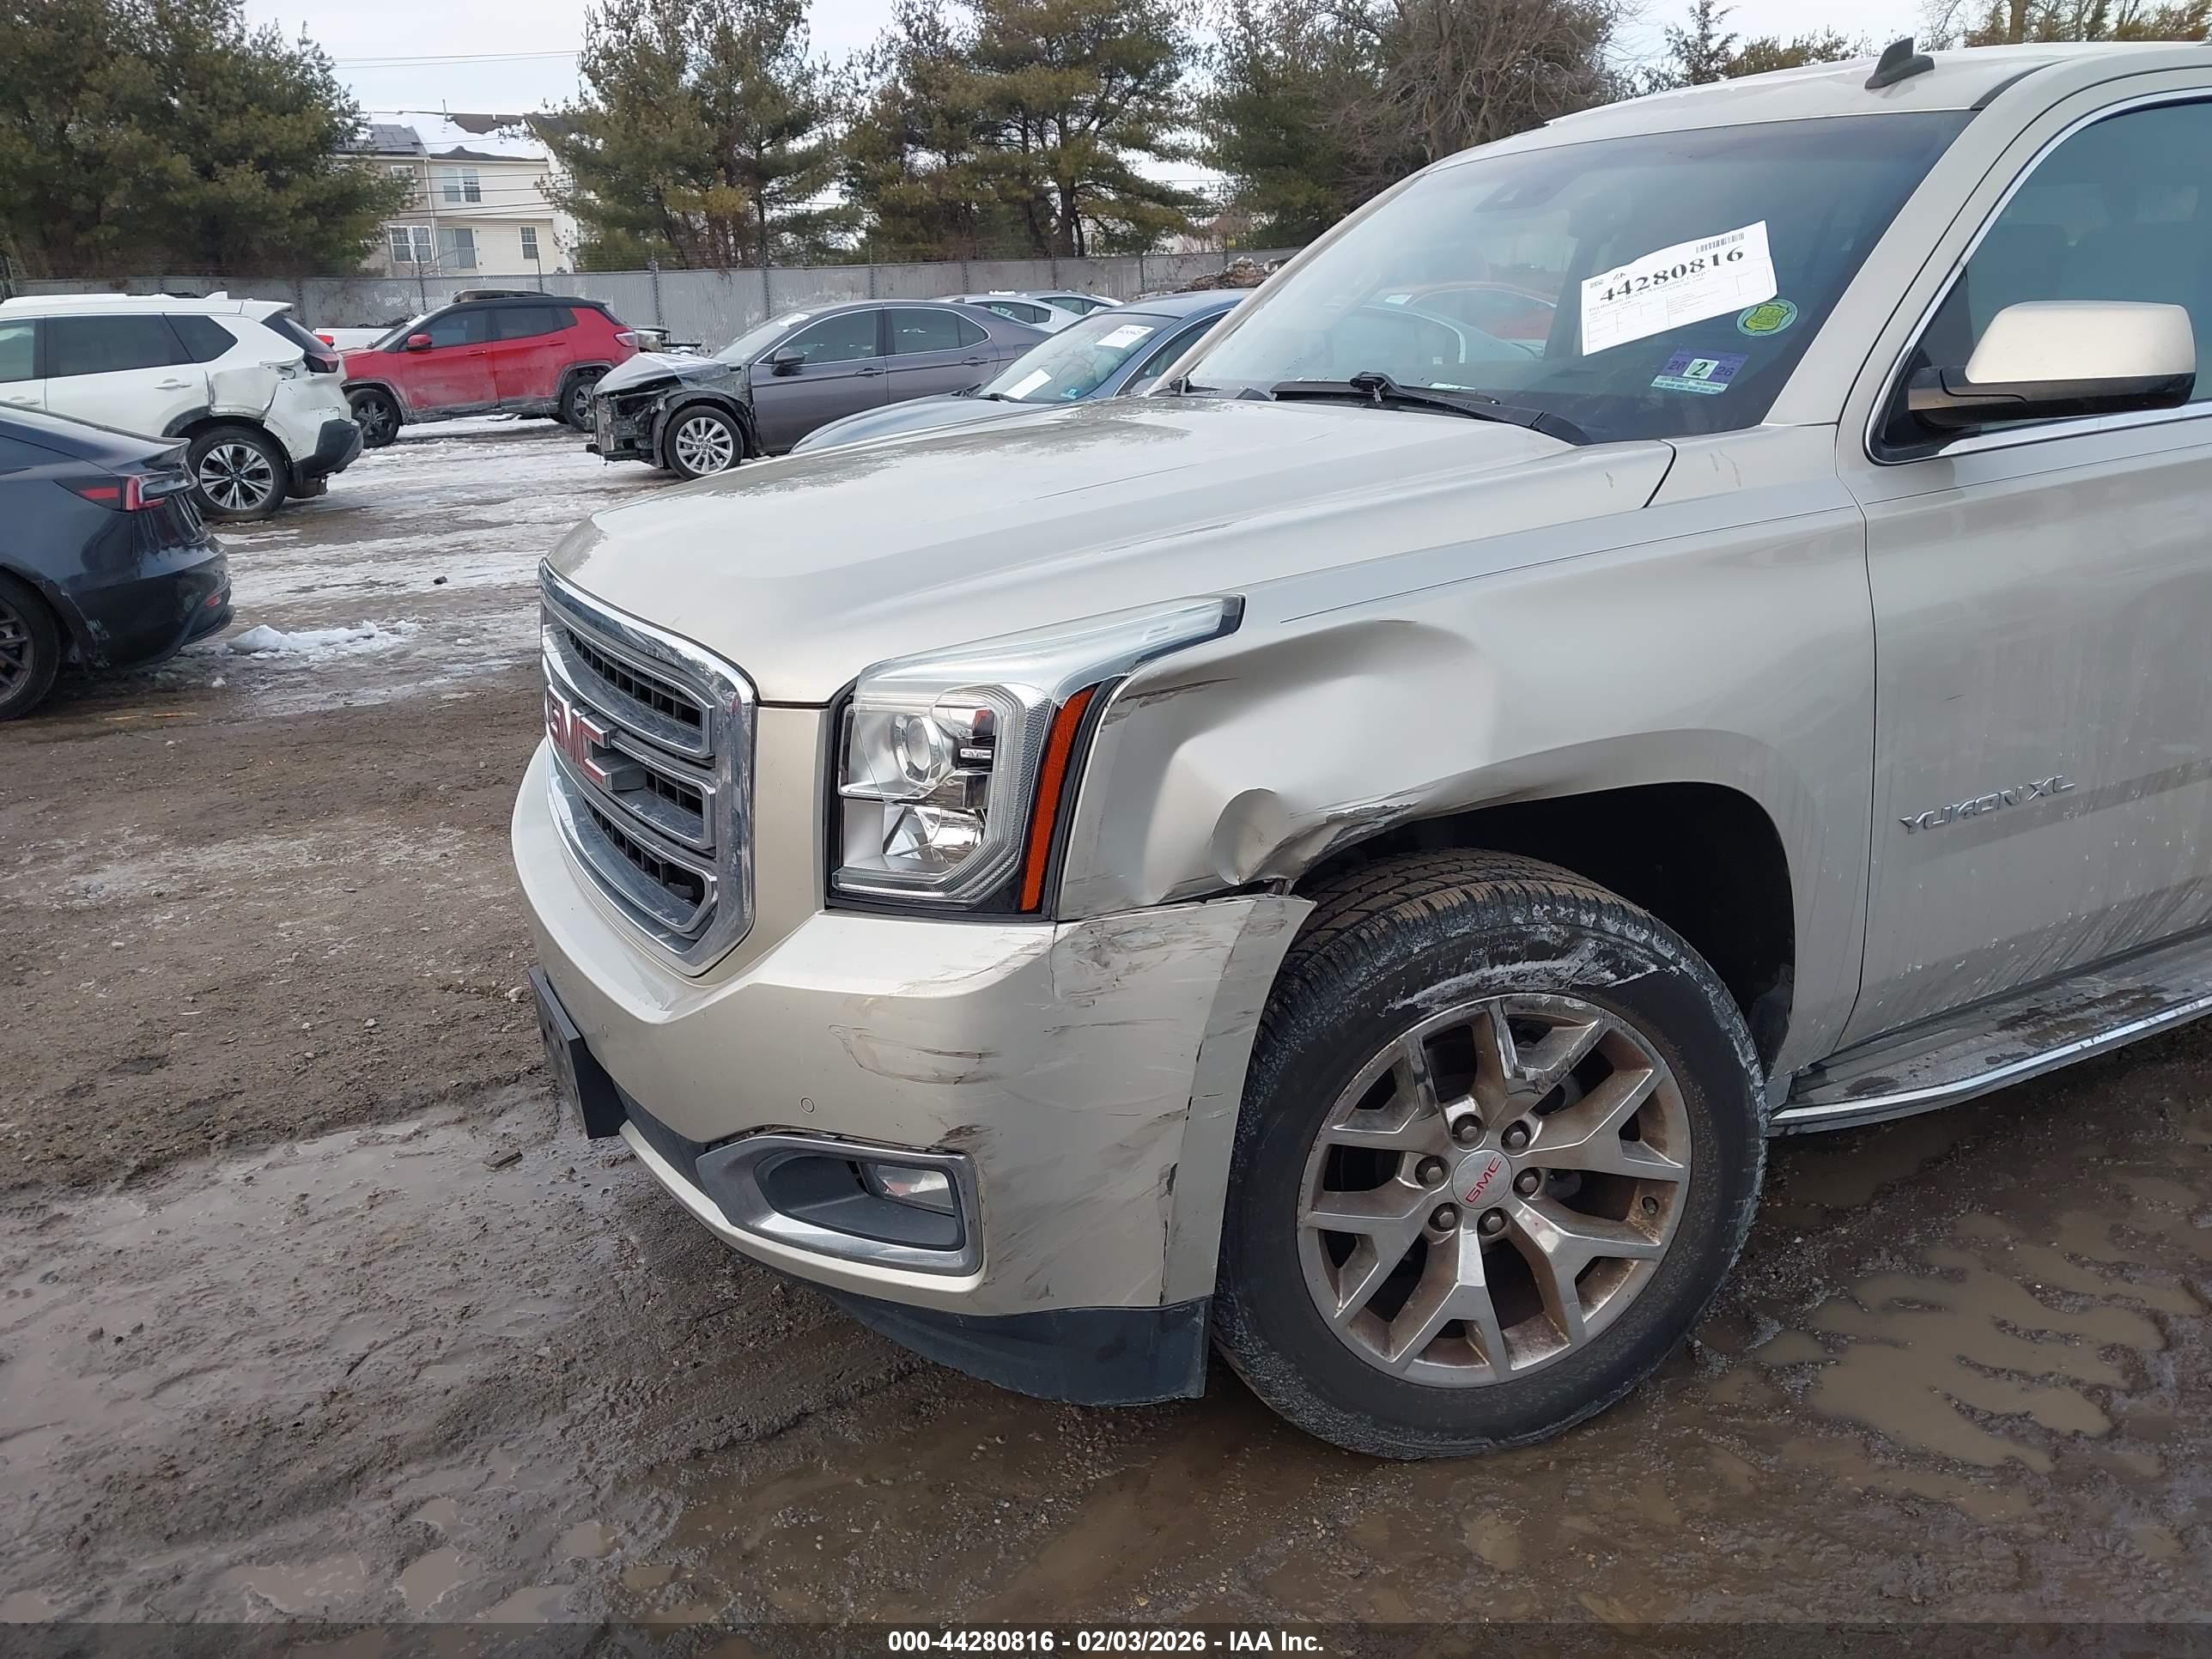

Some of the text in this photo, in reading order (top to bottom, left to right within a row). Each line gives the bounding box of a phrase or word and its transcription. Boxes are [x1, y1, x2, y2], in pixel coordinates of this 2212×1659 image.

[1600, 246, 1744, 301] 44280816
[1668, 360, 1735, 377] 20 2 26
[1899, 775, 2075, 836] YUKON XL
[1465, 1155, 1502, 1203] GMC
